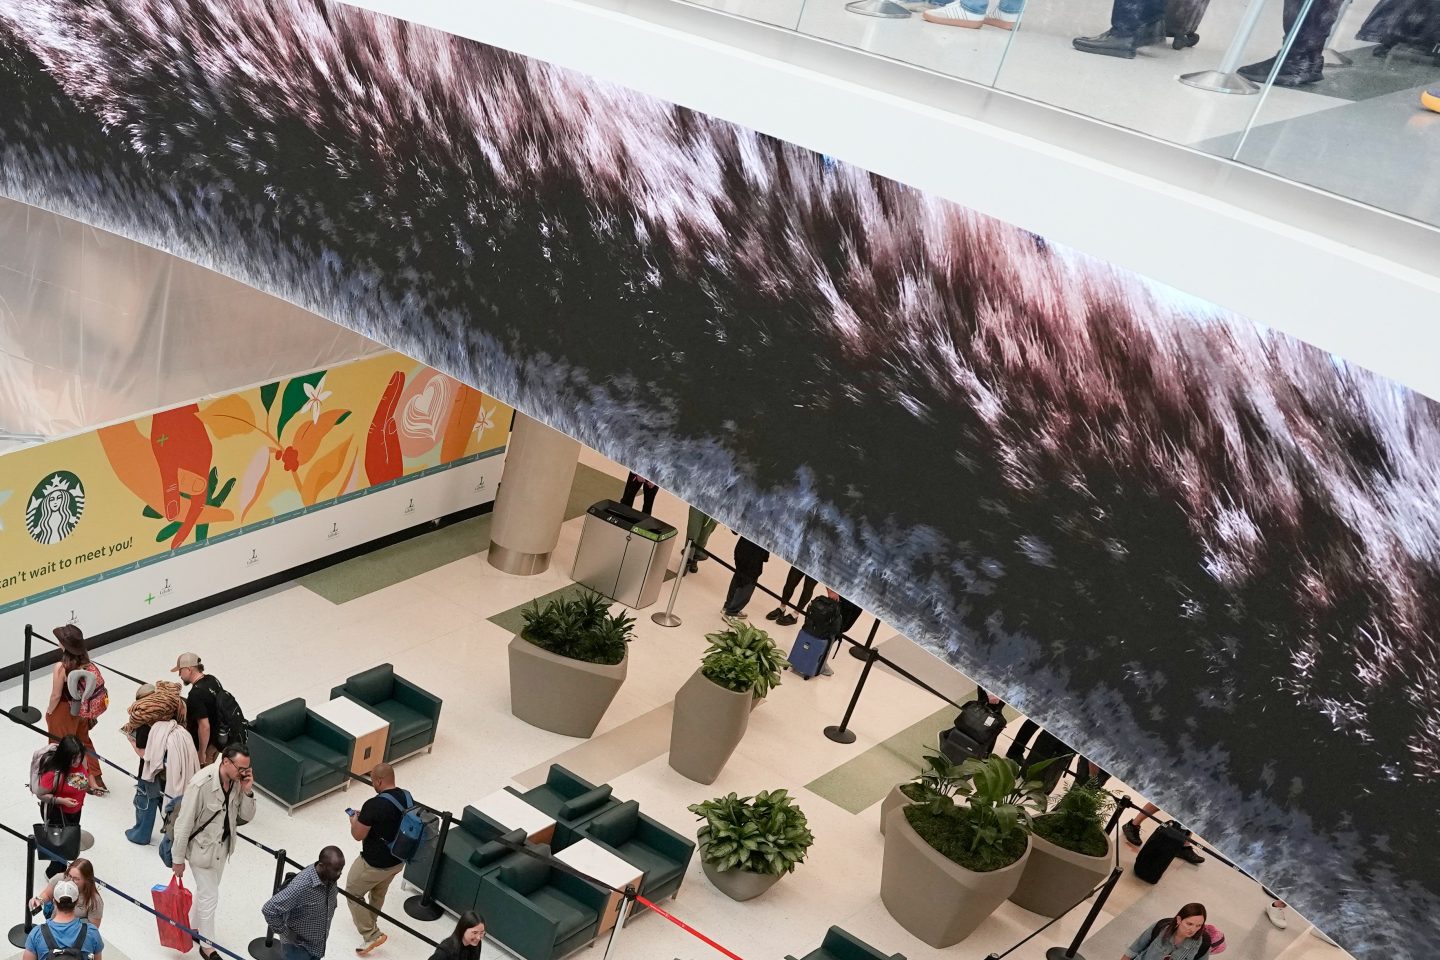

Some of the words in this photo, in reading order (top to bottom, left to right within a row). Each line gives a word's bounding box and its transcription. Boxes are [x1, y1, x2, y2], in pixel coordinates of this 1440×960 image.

[29, 561, 56, 579] wait
[60, 558, 72, 569] to
[75, 546, 106, 565] meet
[109, 536, 133, 556] you!
